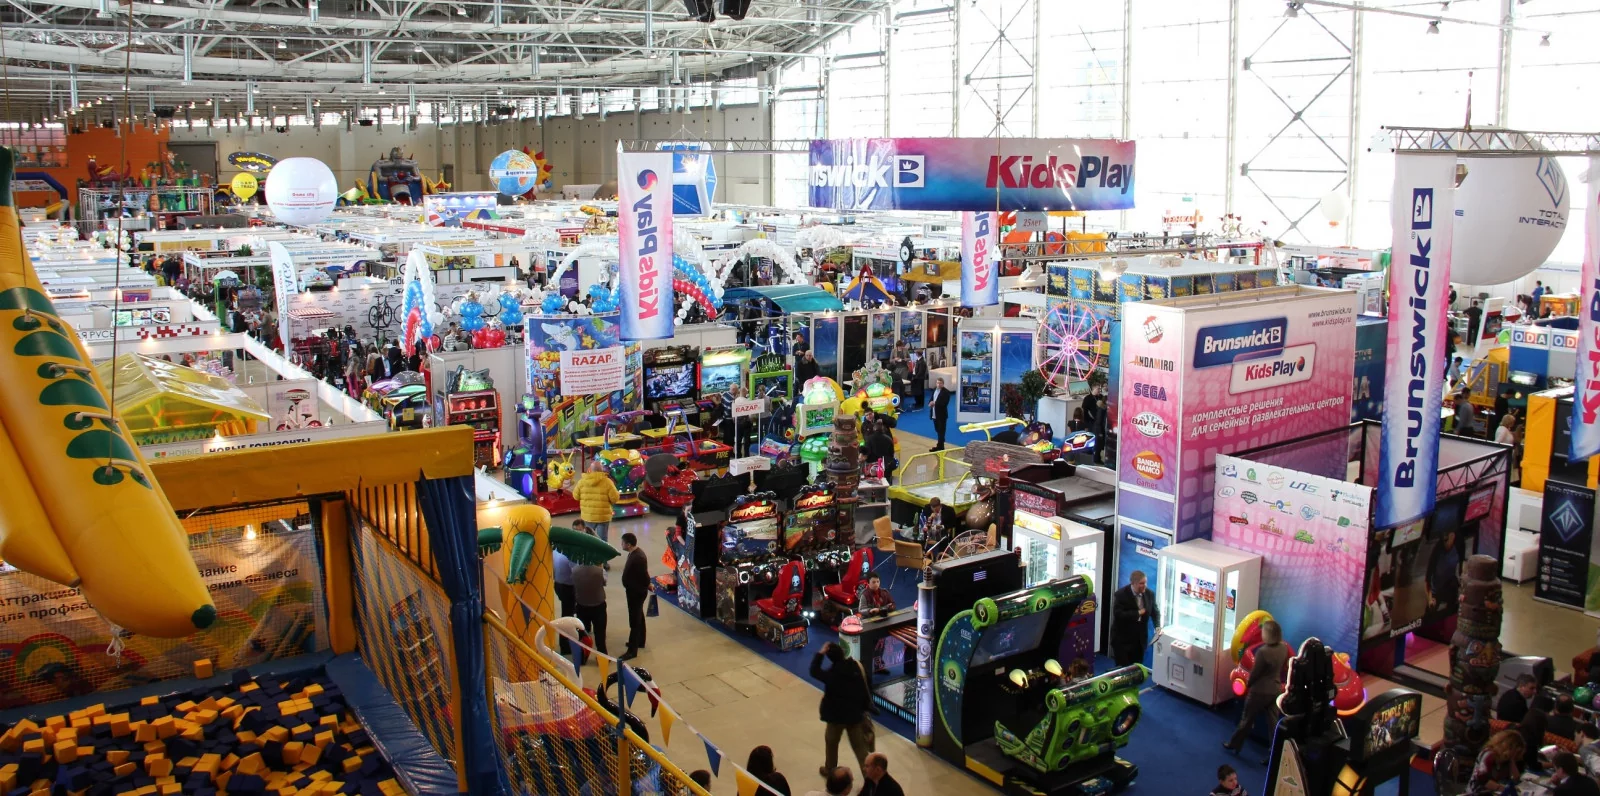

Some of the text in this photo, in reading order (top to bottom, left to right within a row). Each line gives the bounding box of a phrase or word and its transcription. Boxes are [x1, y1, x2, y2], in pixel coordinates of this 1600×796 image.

[985, 155, 1133, 195] KidsPlay
[1203, 328, 1270, 354] Brunswick
[1245, 360, 1297, 381] KidsPlay
[1394, 234, 1432, 488] Brunswick
[1133, 382, 1167, 401] SEGA
[1190, 395, 1345, 438] для семейных развлекательных центров
[1192, 397, 1284, 424] комплексные решения
[1131, 417, 1170, 432] BAY TEK
[1136, 457, 1161, 469] BANDAI
[1136, 463, 1161, 476] NAMCO
[1136, 478, 1158, 490] Games
[245, 568, 299, 584] бизнеса
[1381, 702, 1402, 723] TEMPLE
